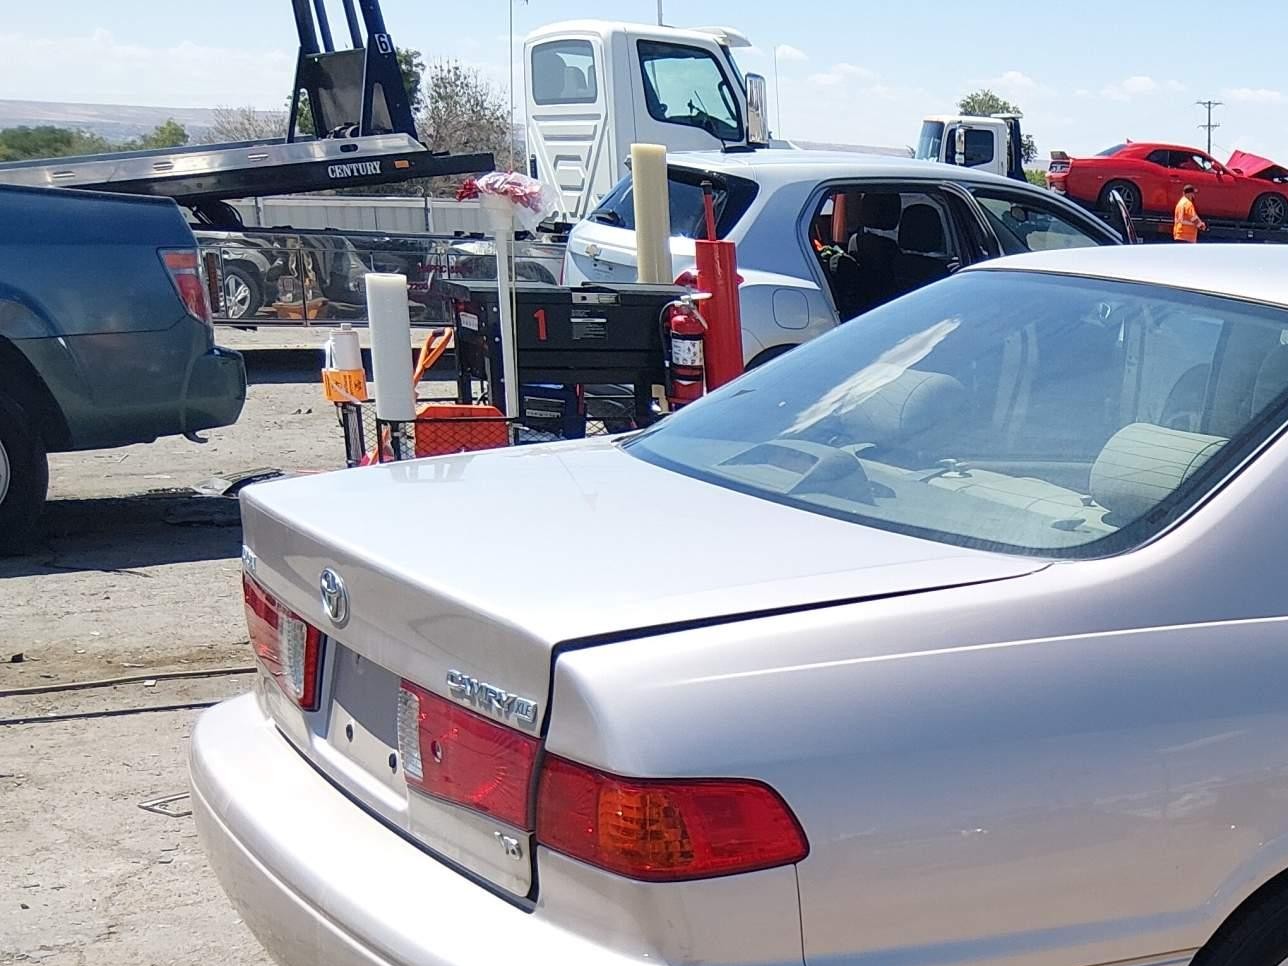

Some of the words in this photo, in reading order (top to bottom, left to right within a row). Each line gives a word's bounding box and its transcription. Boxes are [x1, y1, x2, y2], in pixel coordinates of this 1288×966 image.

[377, 34, 390, 53] 6
[327, 161, 381, 178] CENTURY
[534, 309, 548, 340] 1
[447, 669, 516, 713] CAMRY
[515, 700, 536, 720] XLE
[494, 831, 522, 860] V6
